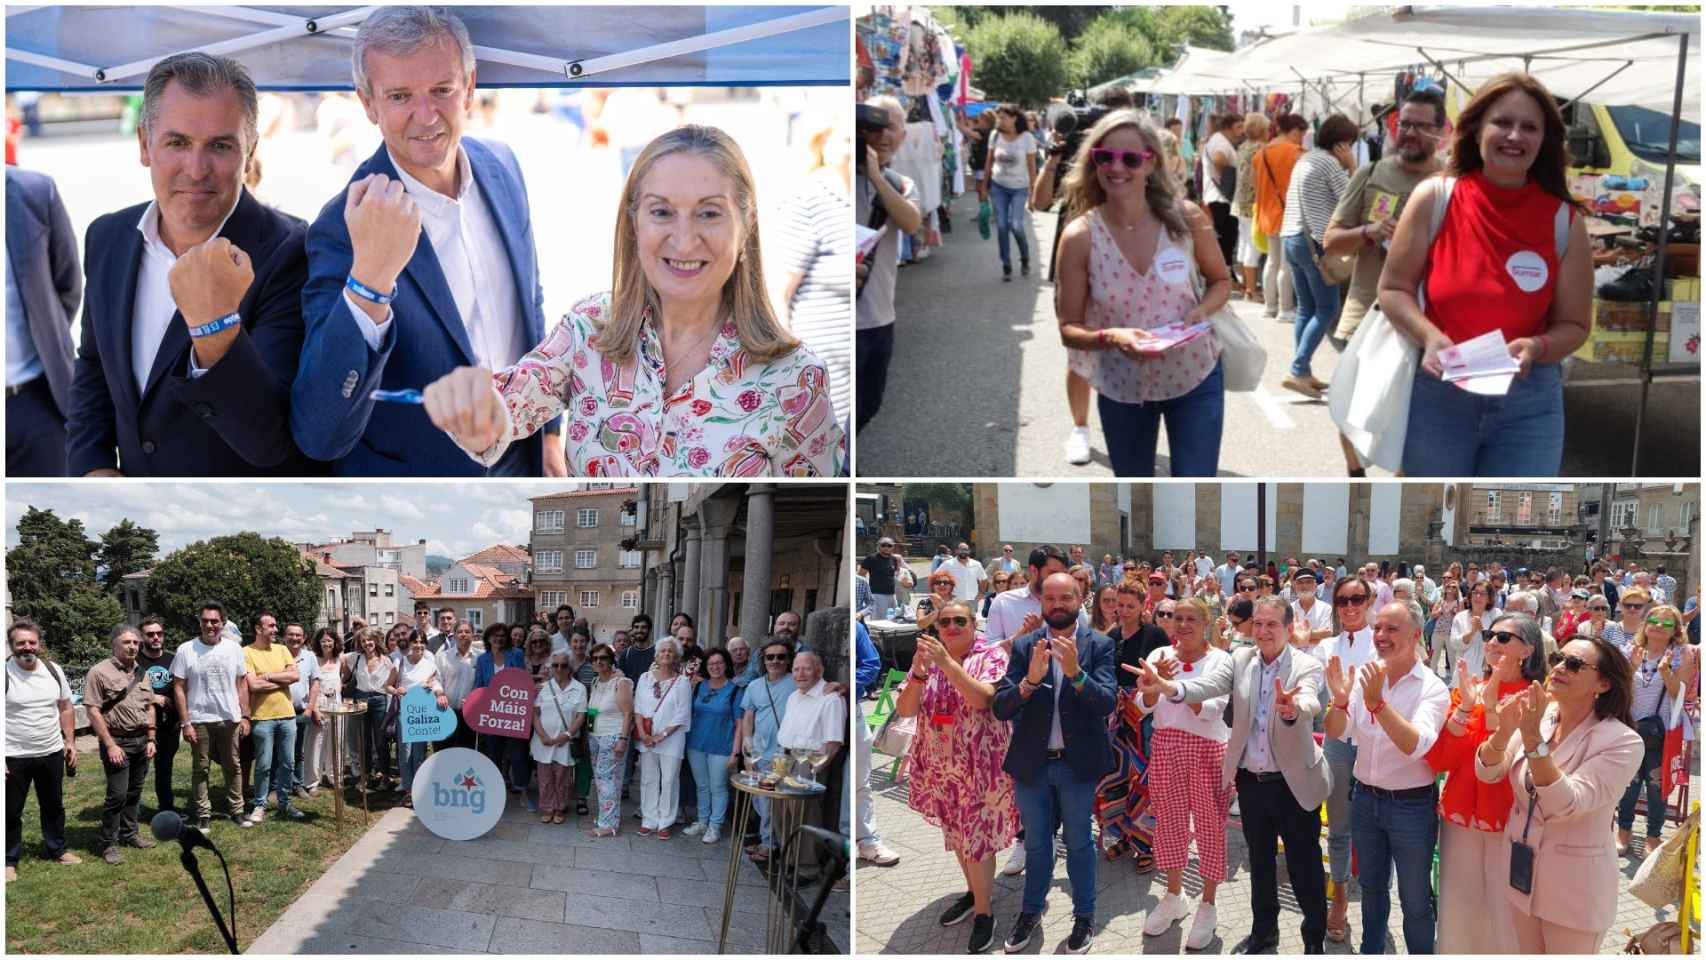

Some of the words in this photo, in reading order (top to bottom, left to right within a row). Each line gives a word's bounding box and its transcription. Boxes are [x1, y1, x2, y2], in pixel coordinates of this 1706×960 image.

[499, 685, 529, 700] Con
[406, 704, 428, 714] Que
[489, 699, 527, 716] Máis
[407, 714, 440, 725] Galiza
[478, 713, 525, 731] Forza!
[407, 725, 440, 736] Conte!
[432, 781, 485, 814] bng
